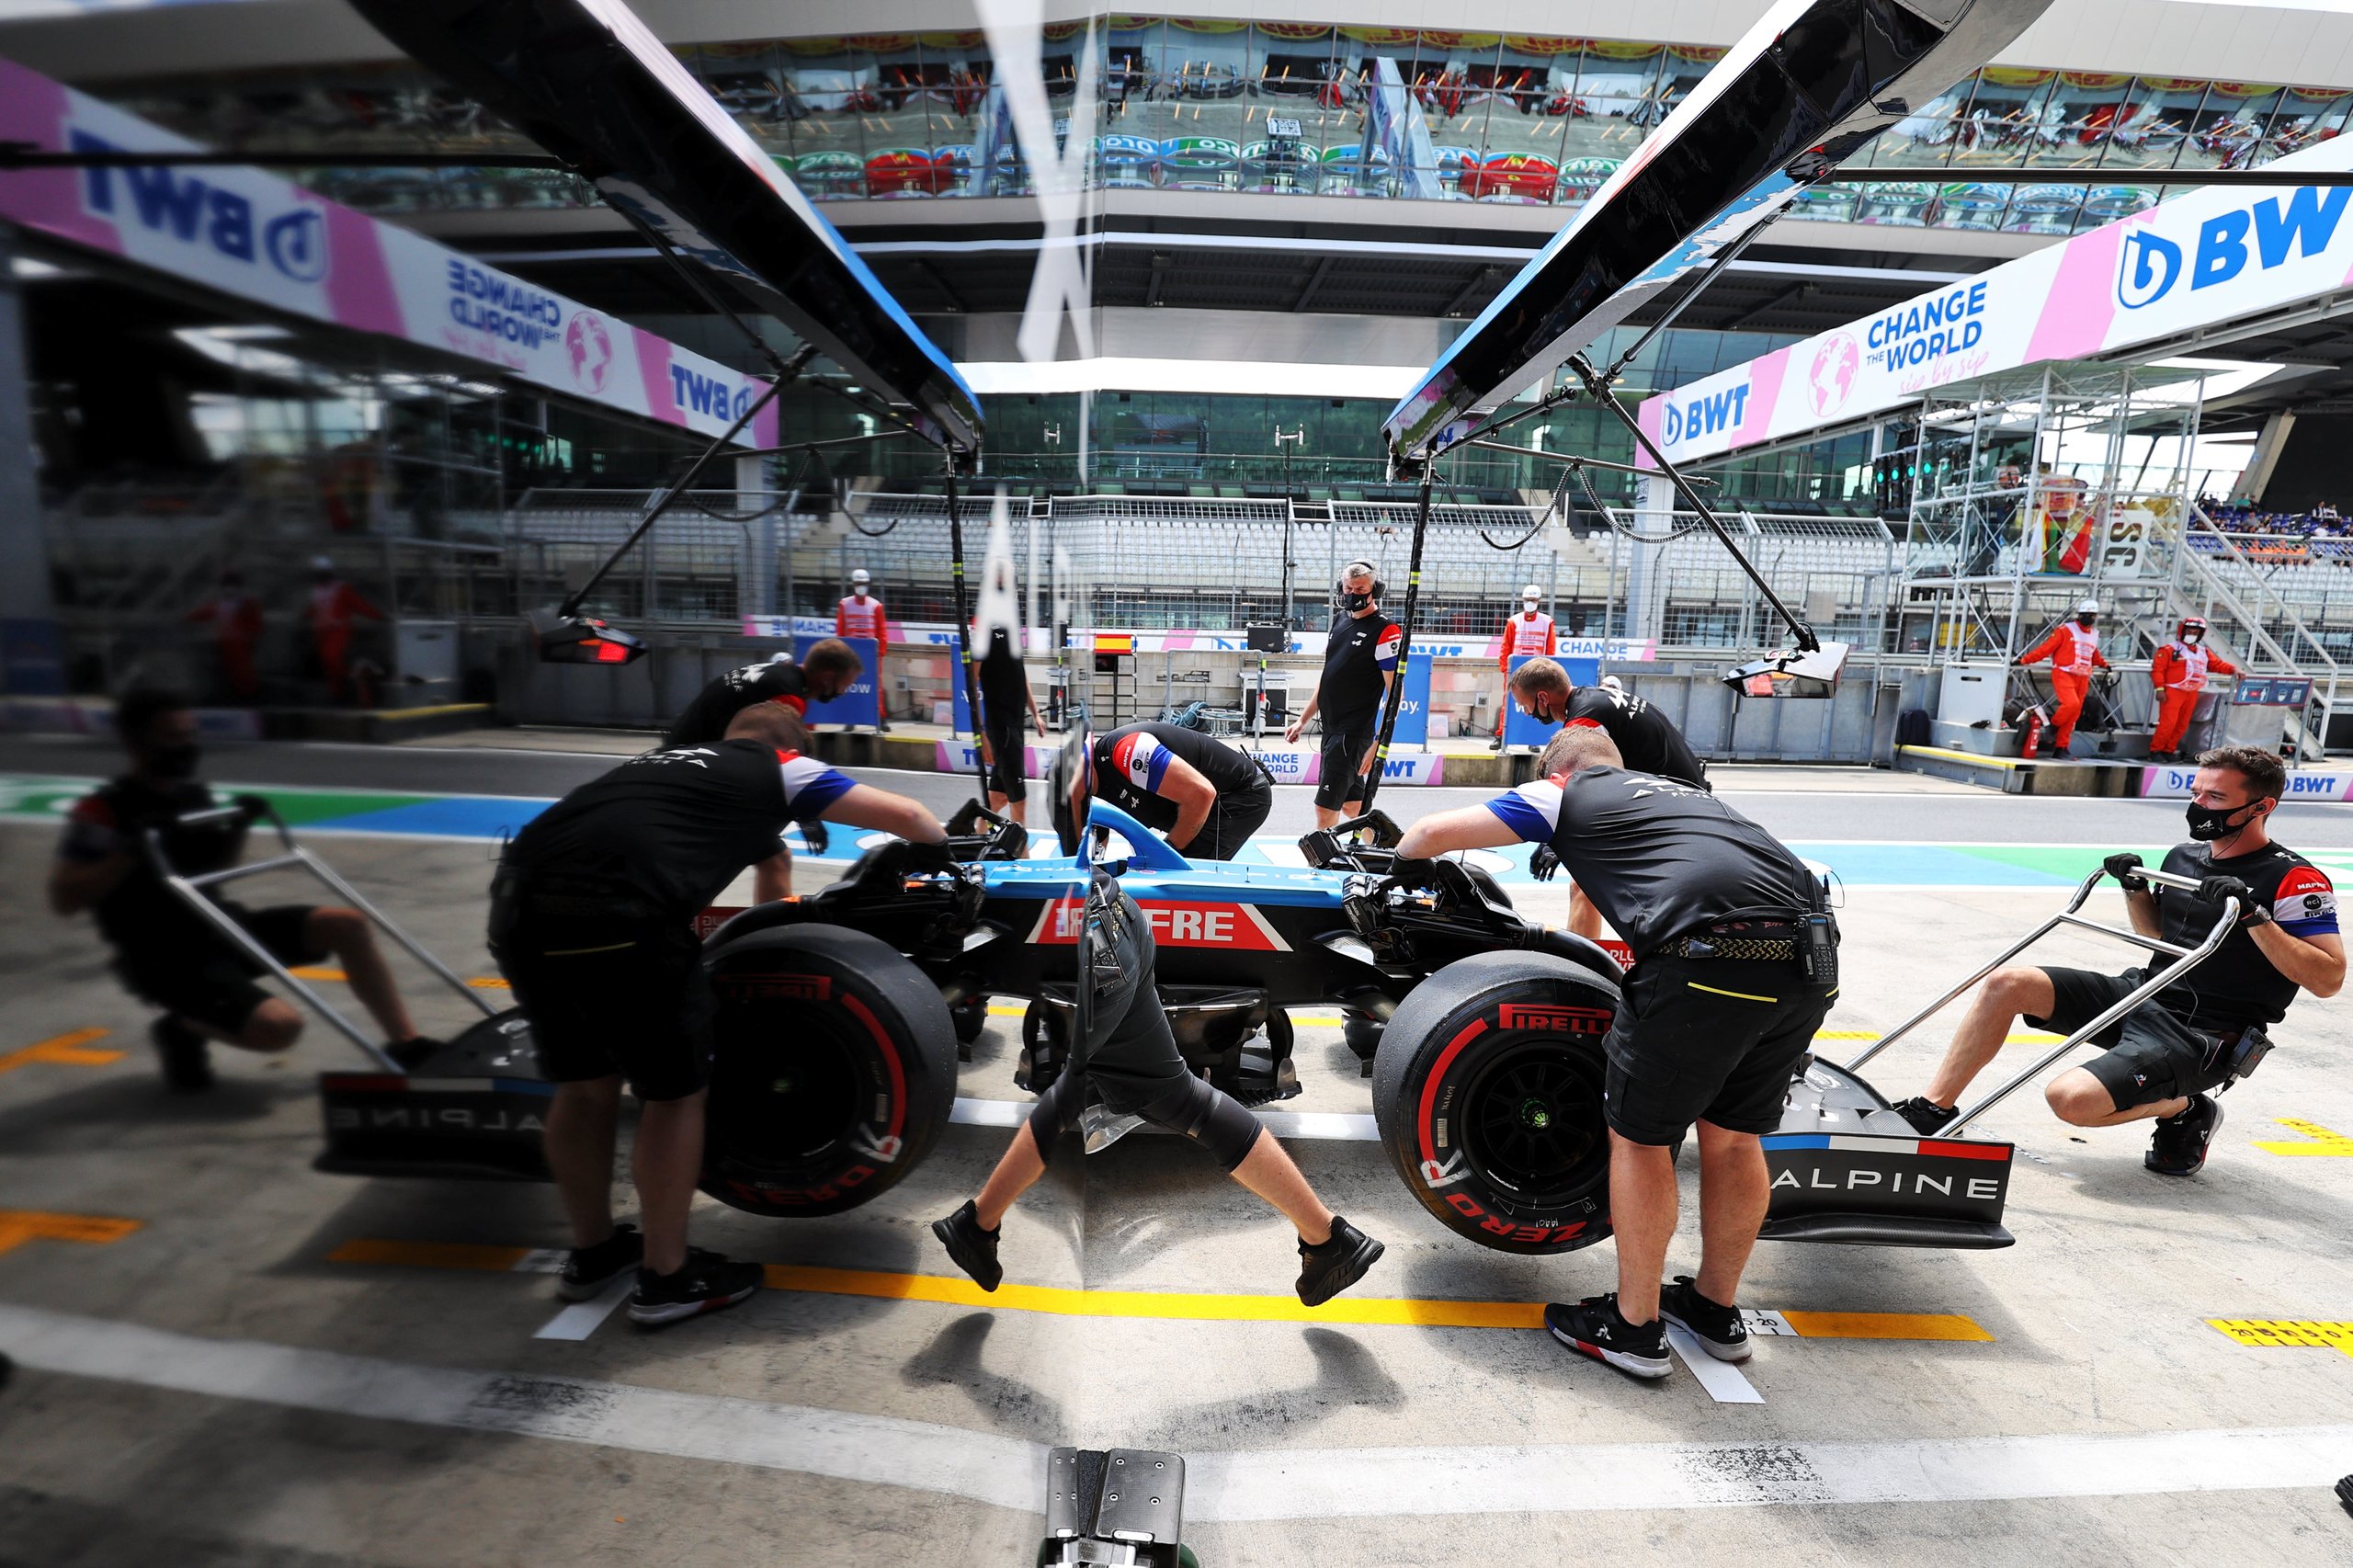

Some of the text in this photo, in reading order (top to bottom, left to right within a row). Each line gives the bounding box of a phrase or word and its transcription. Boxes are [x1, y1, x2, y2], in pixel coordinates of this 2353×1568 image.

[1868, 280, 1987, 349] CHANGE
[1866, 320, 1983, 372] THE WORLD
[1958, 350, 1989, 378] sip
[1685, 382, 1749, 440] BWT
[1250, 754, 1298, 764] HANGE
[1267, 765, 1298, 773] ORLD
[1382, 760, 1416, 778] WT
[2292, 778, 2336, 792] BWT
[1142, 909, 1234, 942] FRE
[1499, 1003, 1612, 1035] PIRELLI
[1770, 1168, 1999, 1199] ALPINE
[1445, 1193, 1587, 1243] ZERO
[1756, 1318, 1779, 1326] 20
